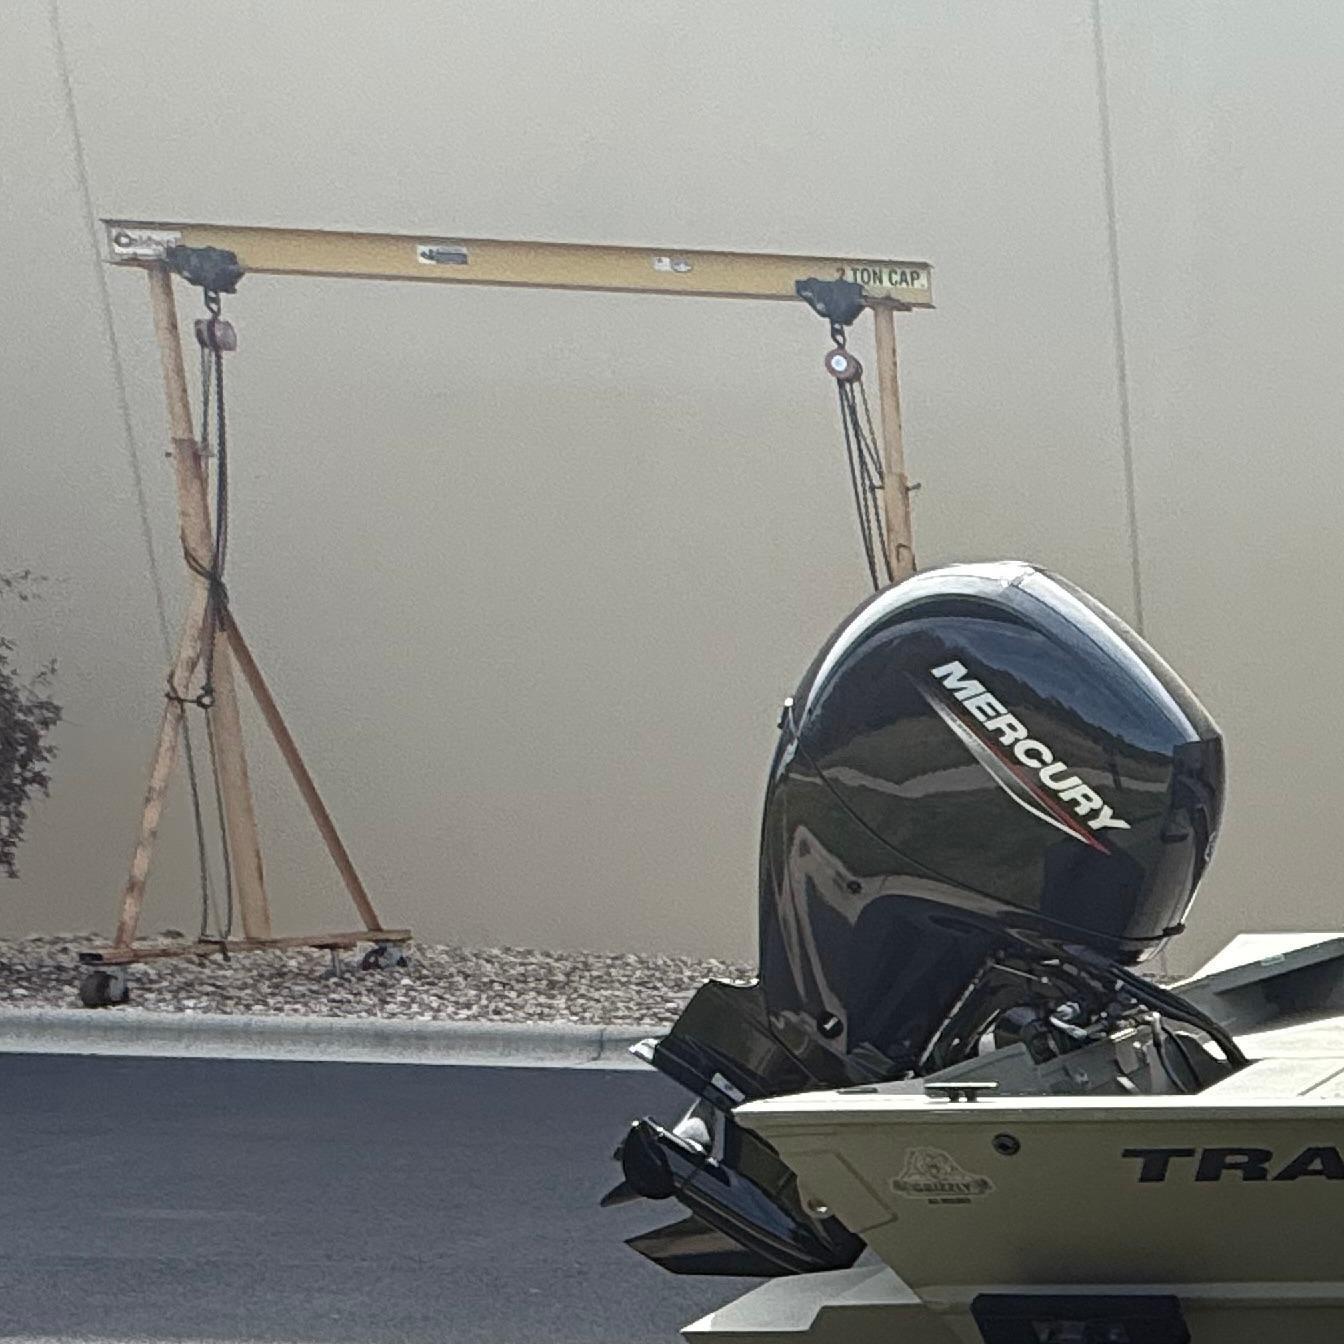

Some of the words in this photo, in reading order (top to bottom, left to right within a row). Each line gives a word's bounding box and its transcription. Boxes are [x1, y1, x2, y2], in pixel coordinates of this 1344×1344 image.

[850, 267, 884, 286] TON
[888, 268, 927, 288] CAP.
[930, 660, 1132, 831] MERCURY
